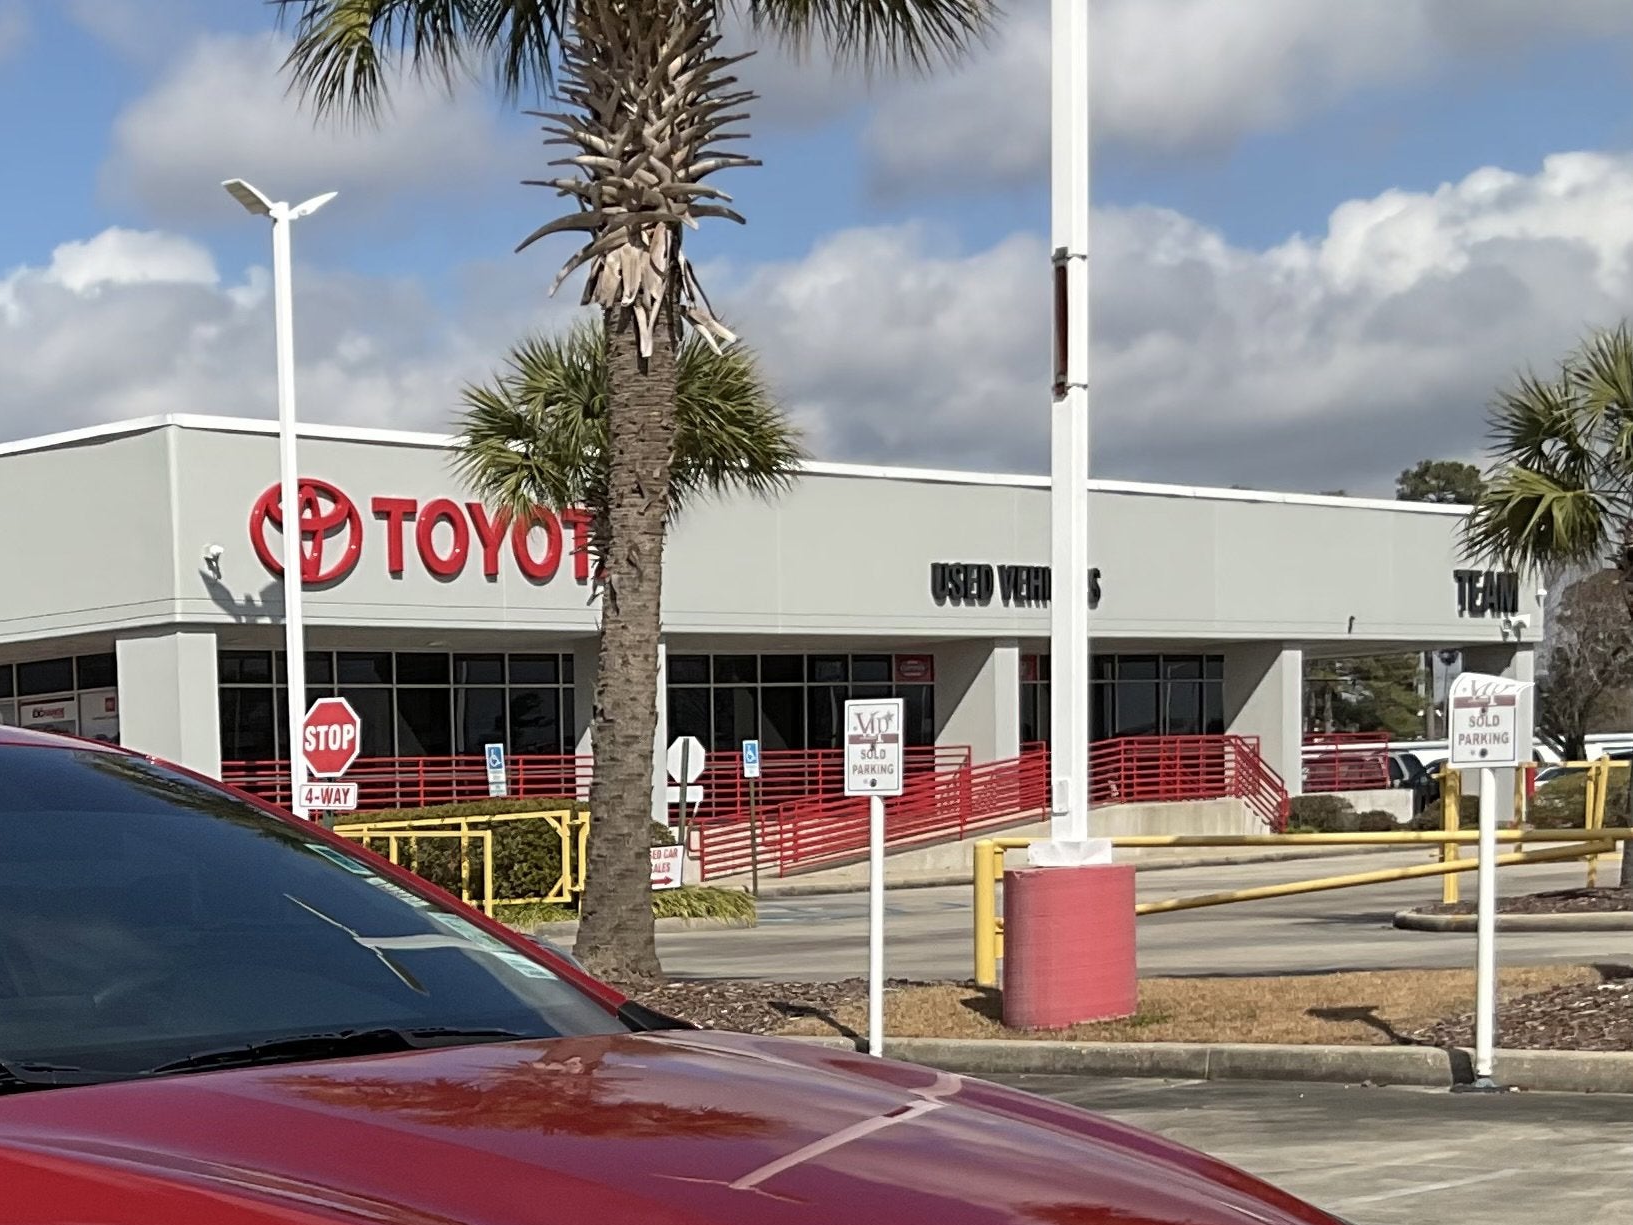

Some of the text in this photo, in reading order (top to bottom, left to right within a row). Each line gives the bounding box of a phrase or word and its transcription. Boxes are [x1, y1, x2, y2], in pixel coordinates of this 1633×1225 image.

[371, 496, 603, 580] TOYOT
[931, 562, 1102, 604] USED VEHIS
[1453, 569, 1519, 614] TEAM
[1468, 714, 1500, 728] SOLD
[304, 723, 355, 752] STOP
[1458, 731, 1509, 746] PARKING
[860, 748, 887, 760] SOLD
[852, 763, 894, 775] PARKING
[304, 787, 350, 805] 4-WAY
[652, 862, 671, 873] ALES
